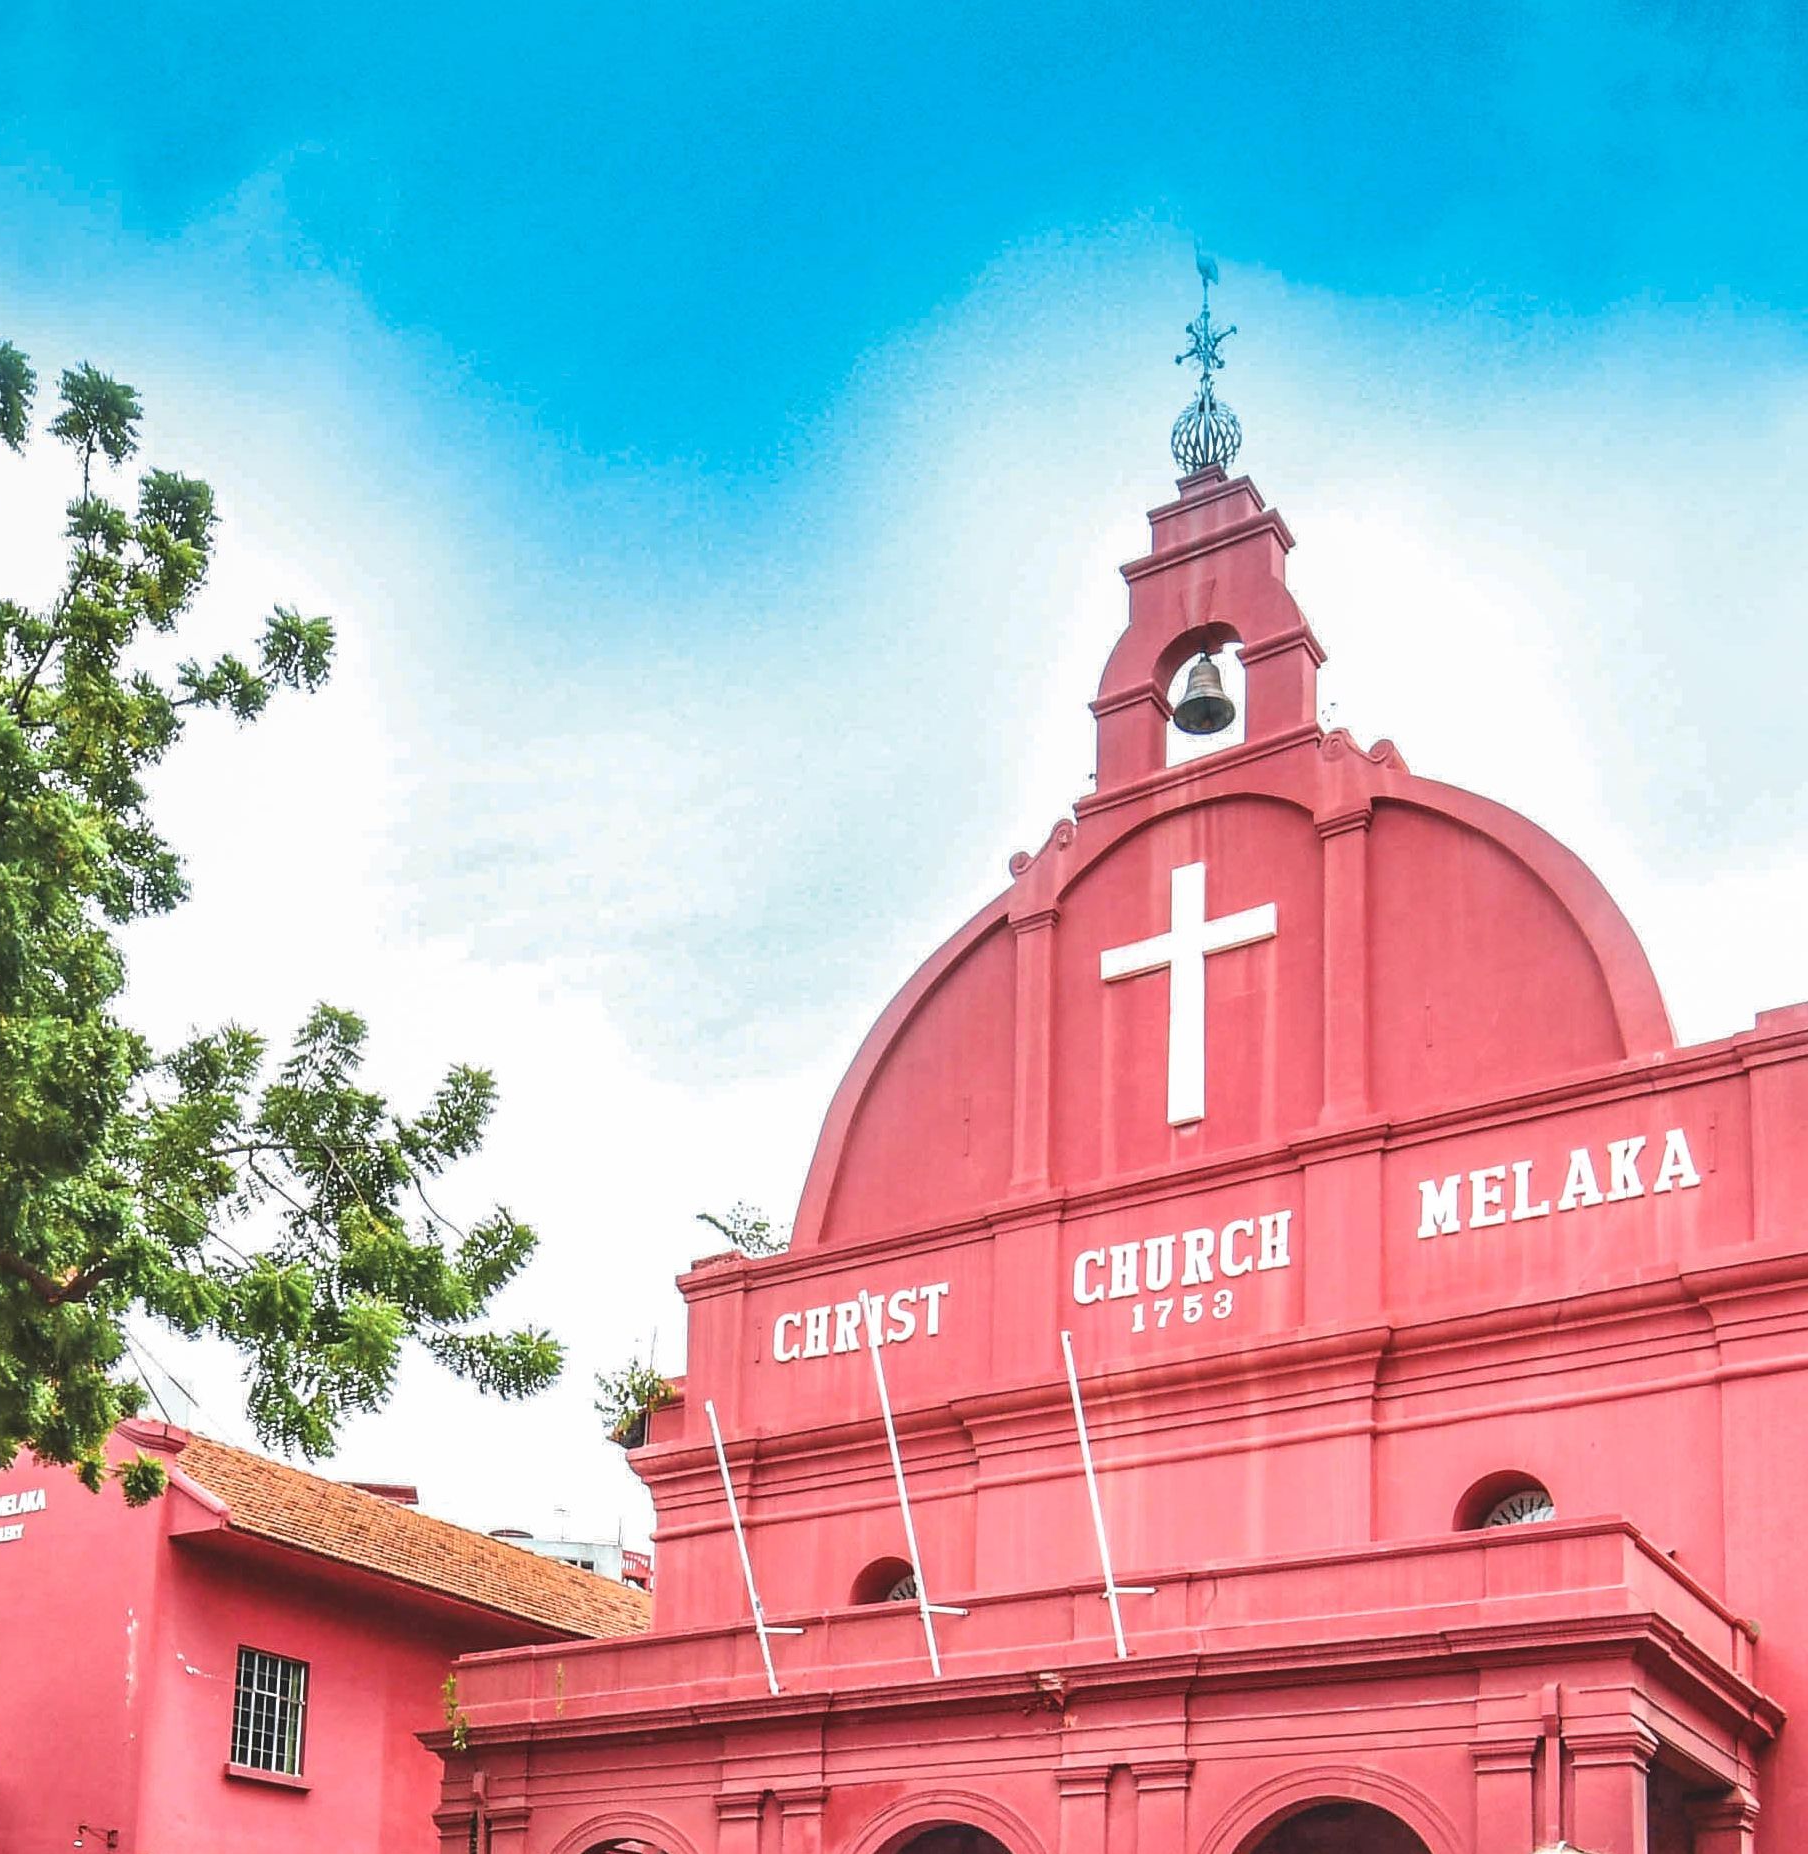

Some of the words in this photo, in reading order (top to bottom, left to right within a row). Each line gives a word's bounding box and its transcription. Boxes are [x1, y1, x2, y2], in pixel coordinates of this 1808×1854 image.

[1417, 1127, 1701, 1240] MELAKA
[1073, 1210, 1292, 1305] CHURCH
[773, 1282, 950, 1364] CHRIST
[1131, 1288, 1234, 1333] 1753
